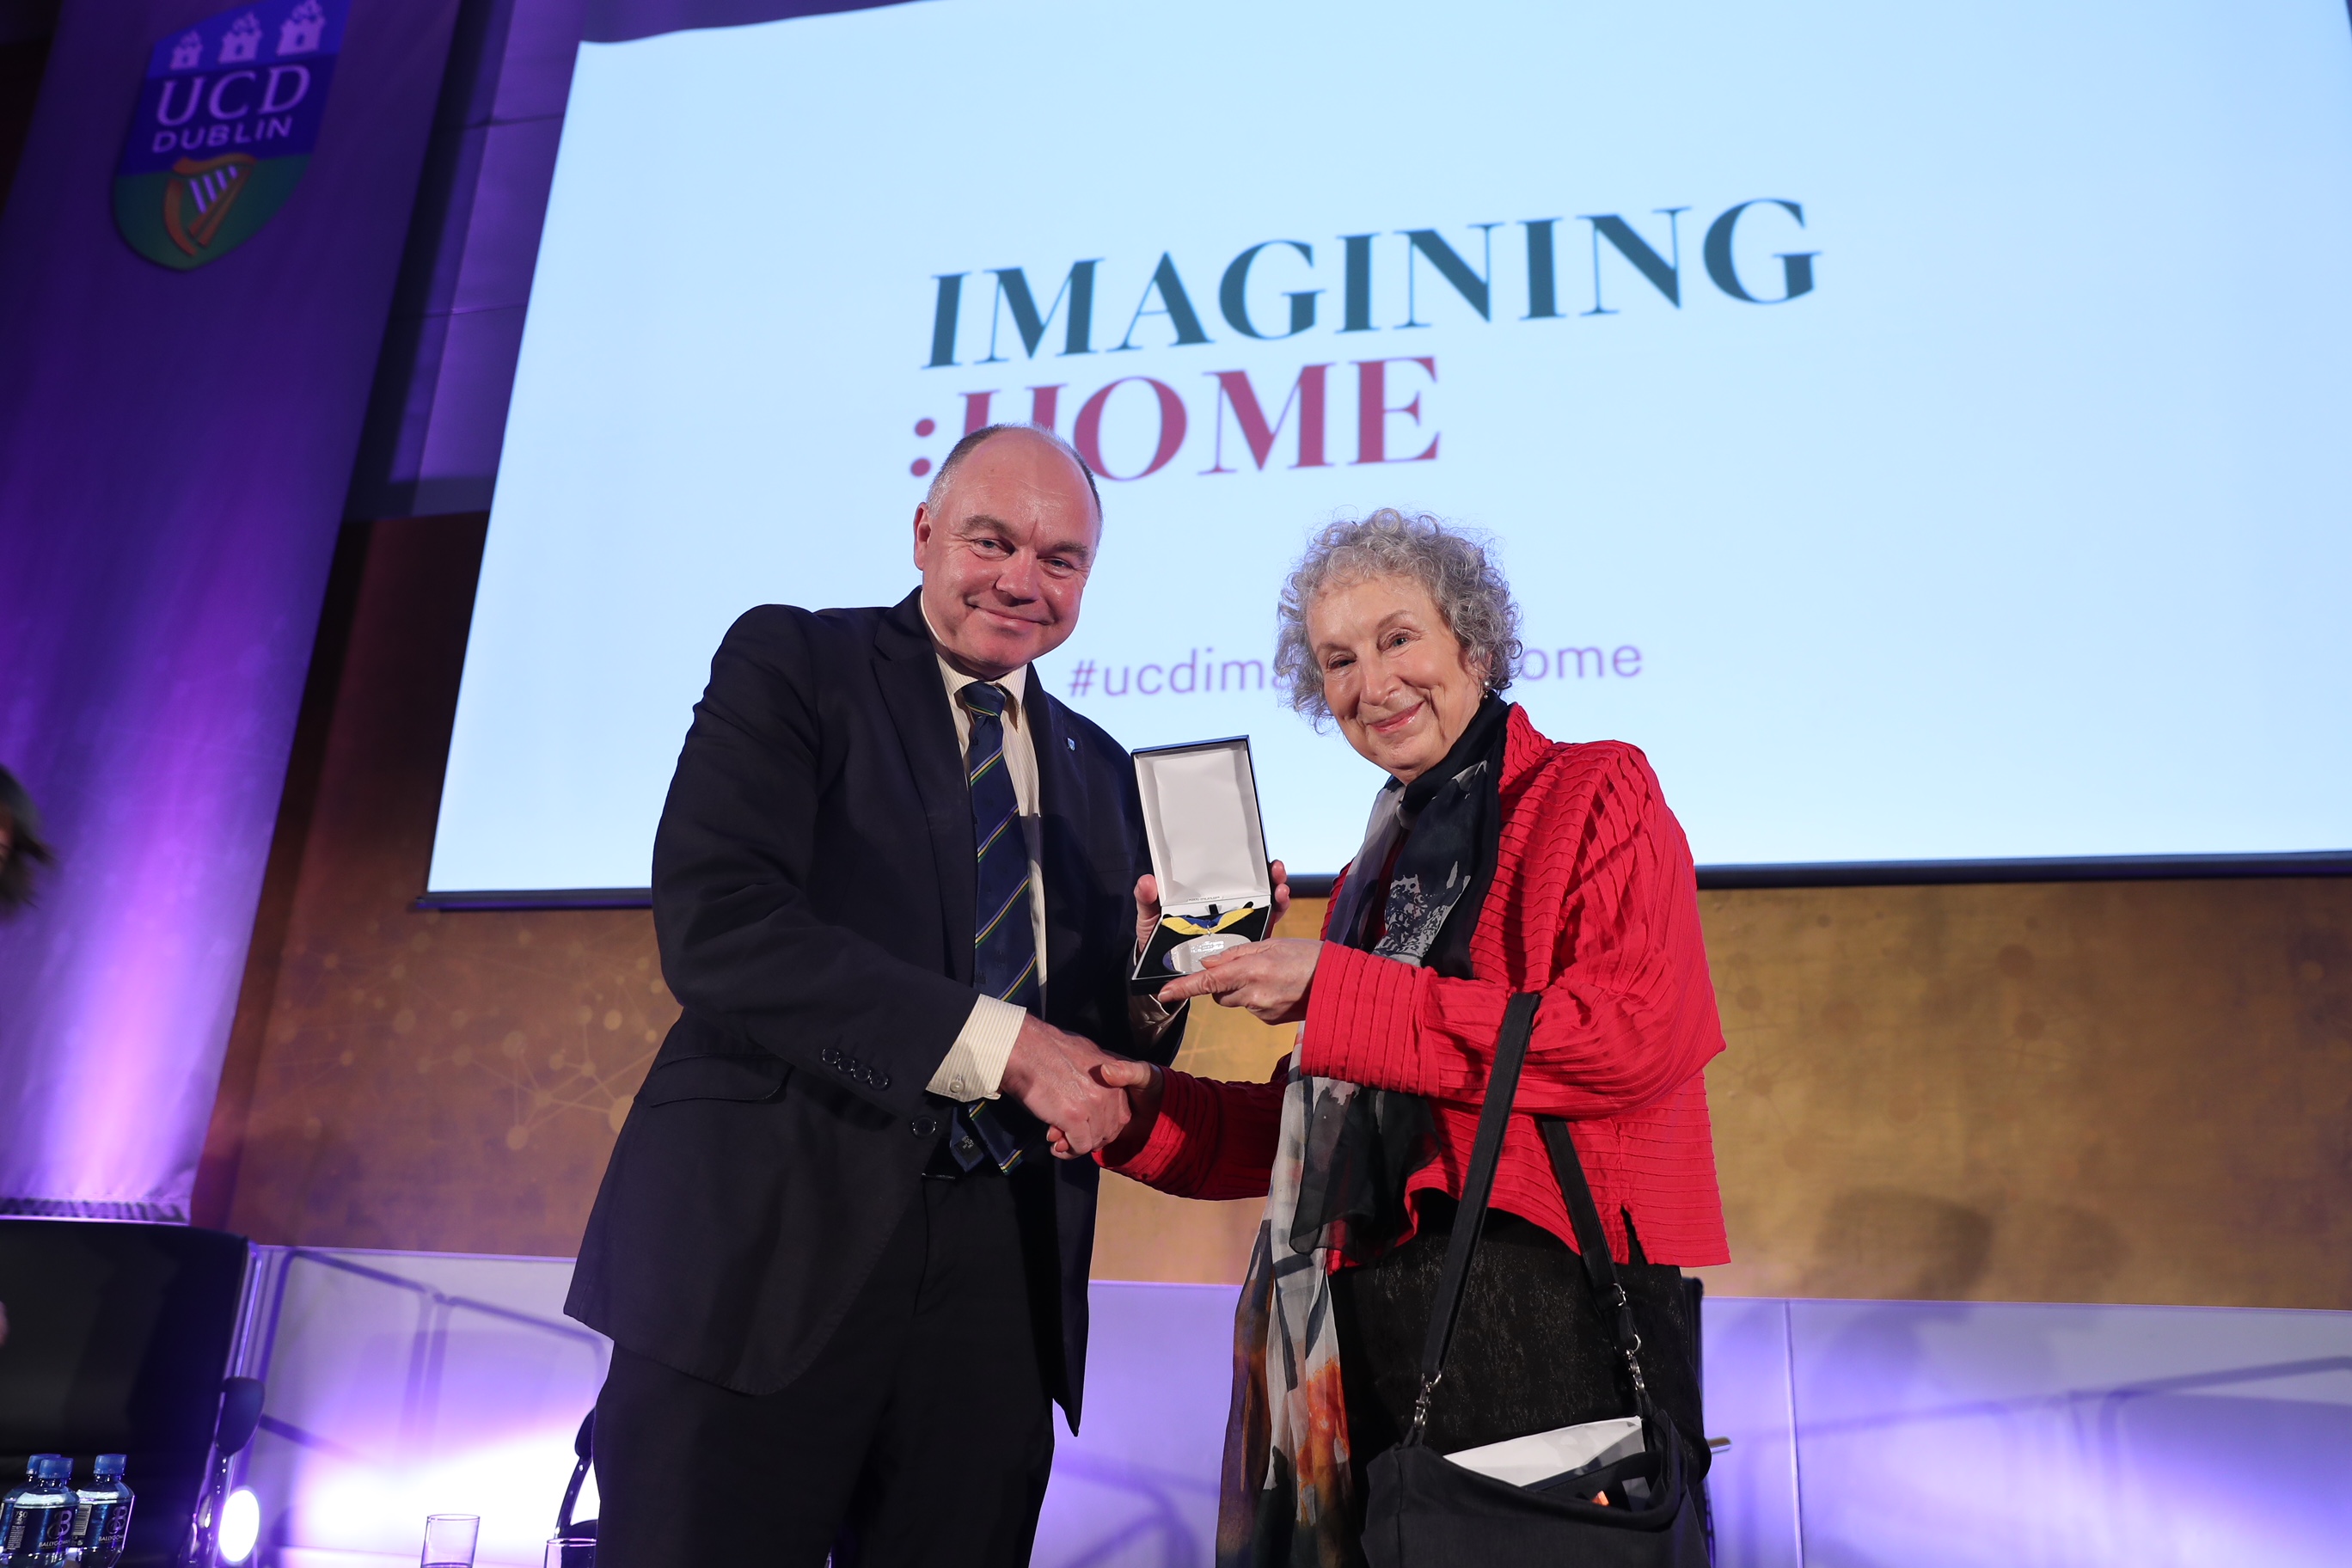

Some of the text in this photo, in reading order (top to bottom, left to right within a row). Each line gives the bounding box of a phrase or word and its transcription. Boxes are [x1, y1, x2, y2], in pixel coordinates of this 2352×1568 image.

[156, 64, 311, 126] UCD
[151, 115, 293, 153] DUBLIN
[921, 197, 1822, 370] IMAGINING
